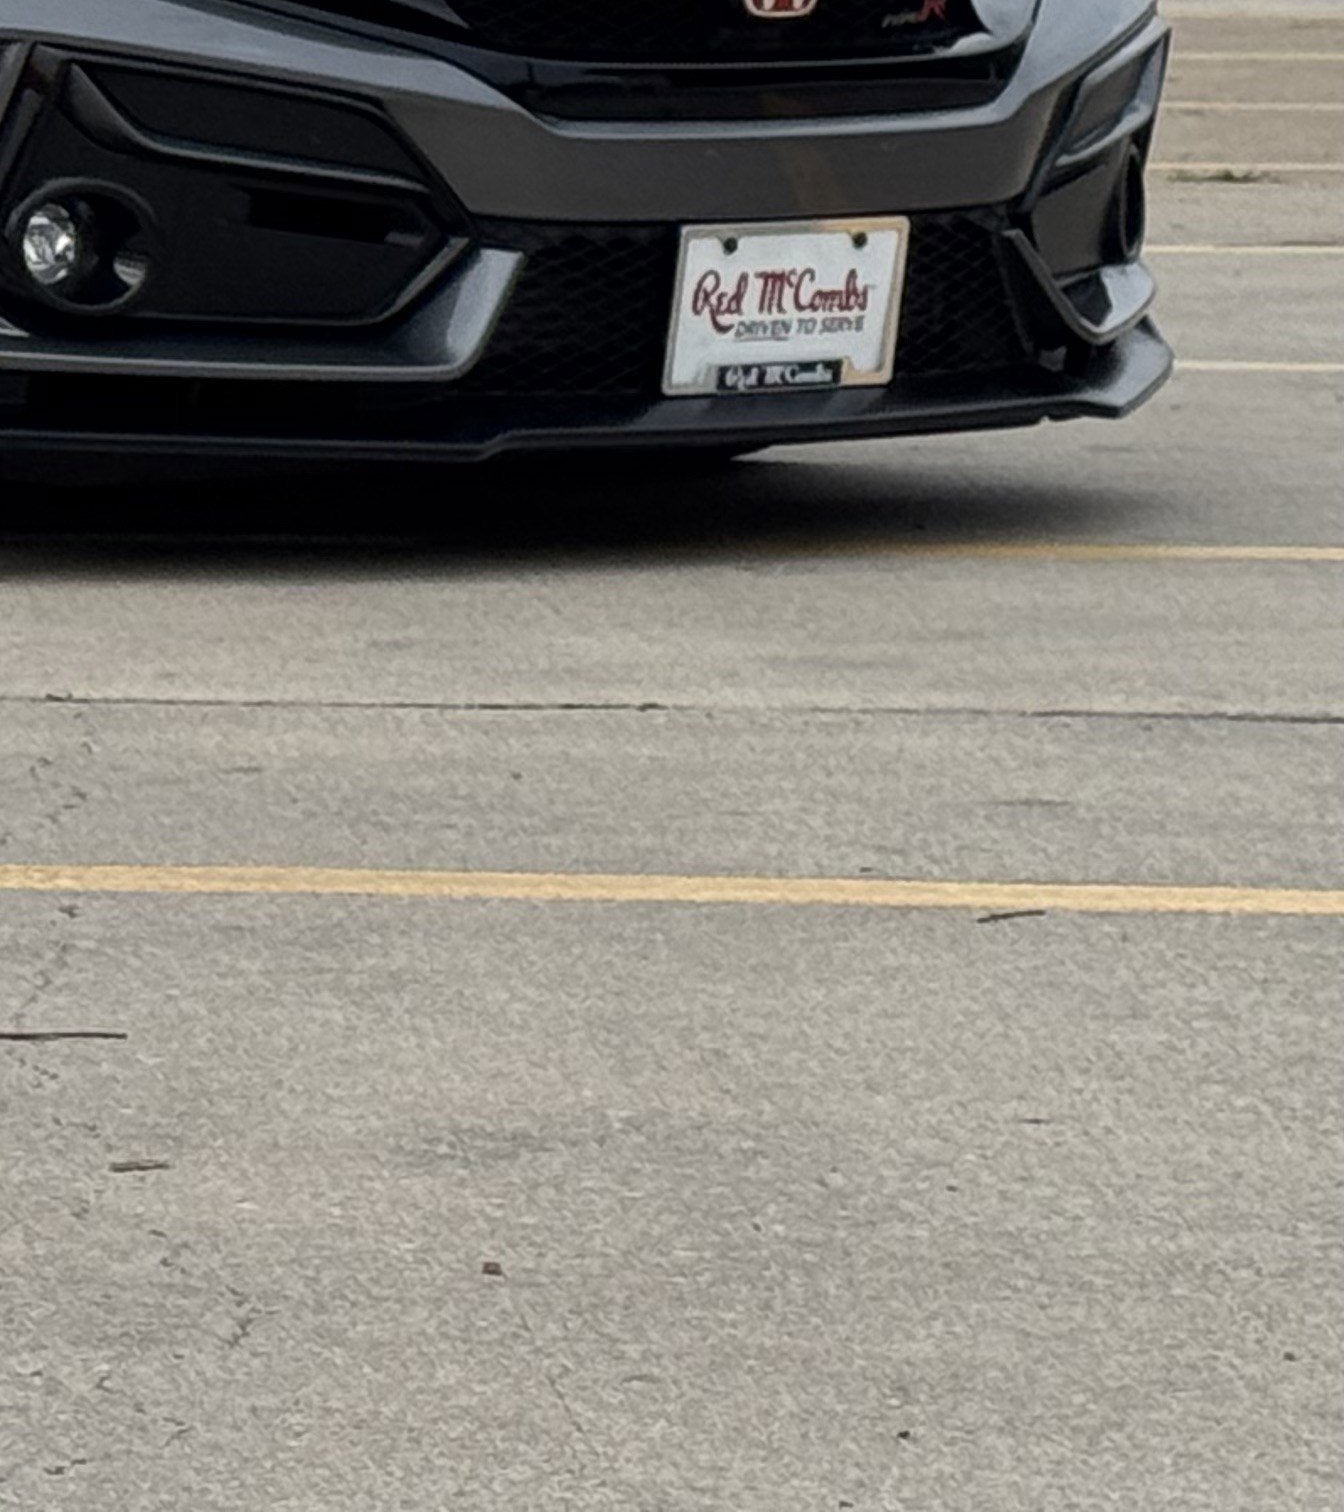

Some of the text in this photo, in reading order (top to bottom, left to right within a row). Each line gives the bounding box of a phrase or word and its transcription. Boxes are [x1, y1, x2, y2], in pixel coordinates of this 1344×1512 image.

[691, 268, 869, 334] Red McCombs
[734, 315, 865, 337] DRIVEN TO SERVE
